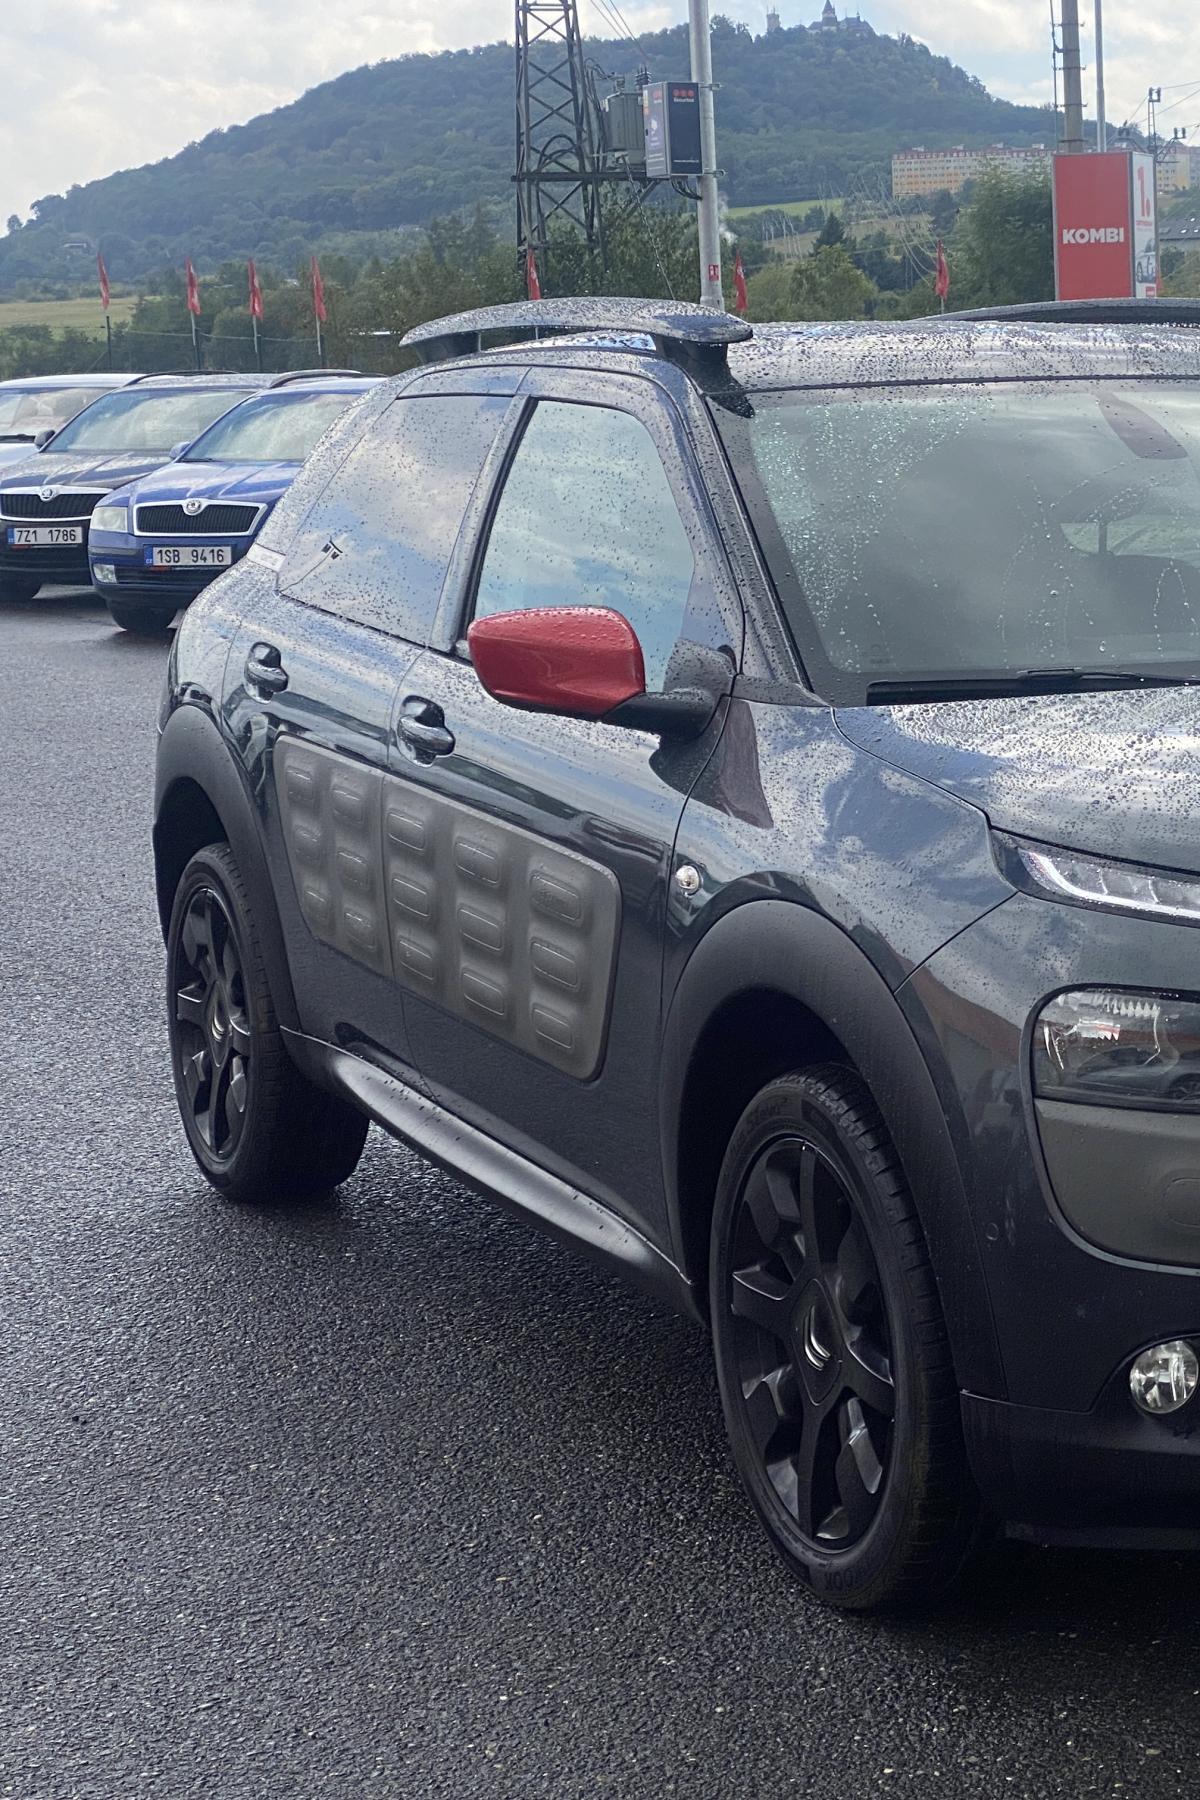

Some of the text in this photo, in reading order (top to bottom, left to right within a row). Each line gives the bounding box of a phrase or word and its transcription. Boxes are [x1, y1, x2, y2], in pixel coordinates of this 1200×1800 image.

[1062, 227, 1125, 244] KOMBI
[16, 530, 38, 543] 7Z1
[48, 529, 76, 542] 1786
[157, 549, 224, 563] 1SB 9416
